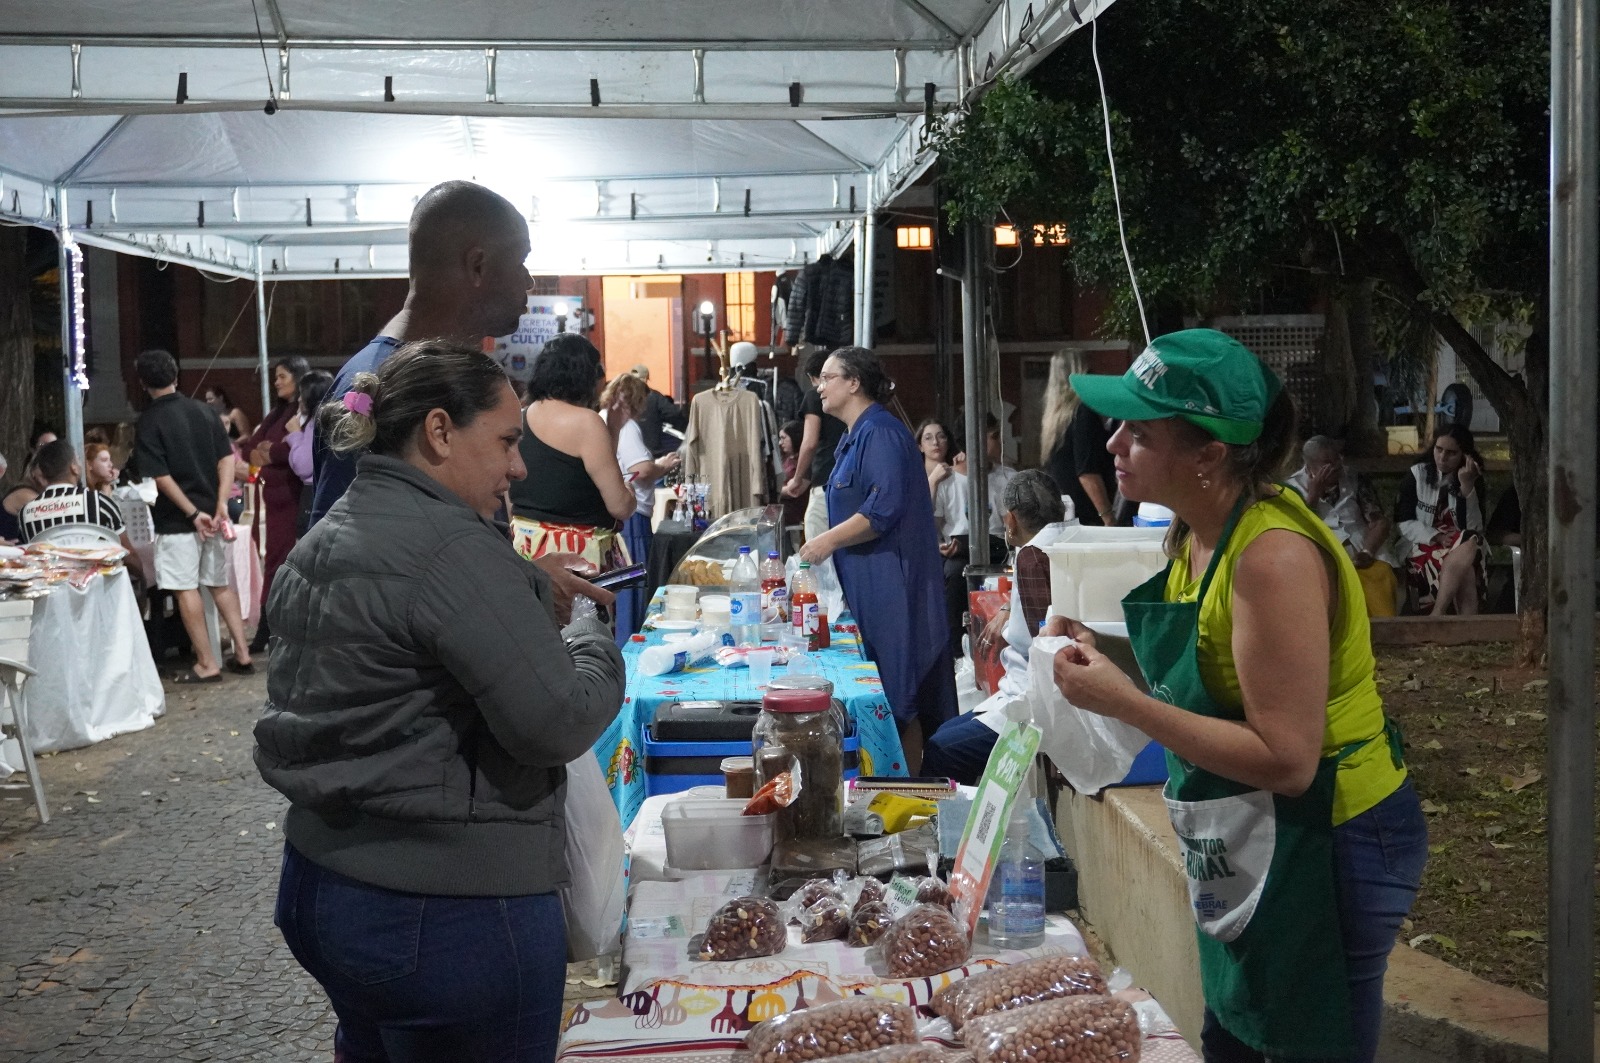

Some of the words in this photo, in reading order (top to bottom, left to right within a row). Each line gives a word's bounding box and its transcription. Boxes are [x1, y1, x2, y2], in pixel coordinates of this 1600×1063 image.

[516, 327, 554, 335] UNICIPAL
[26, 500, 81, 514] DEMOCRACIA
[1000, 757, 1020, 785] PIX
[1187, 849, 1236, 881] RURAL
